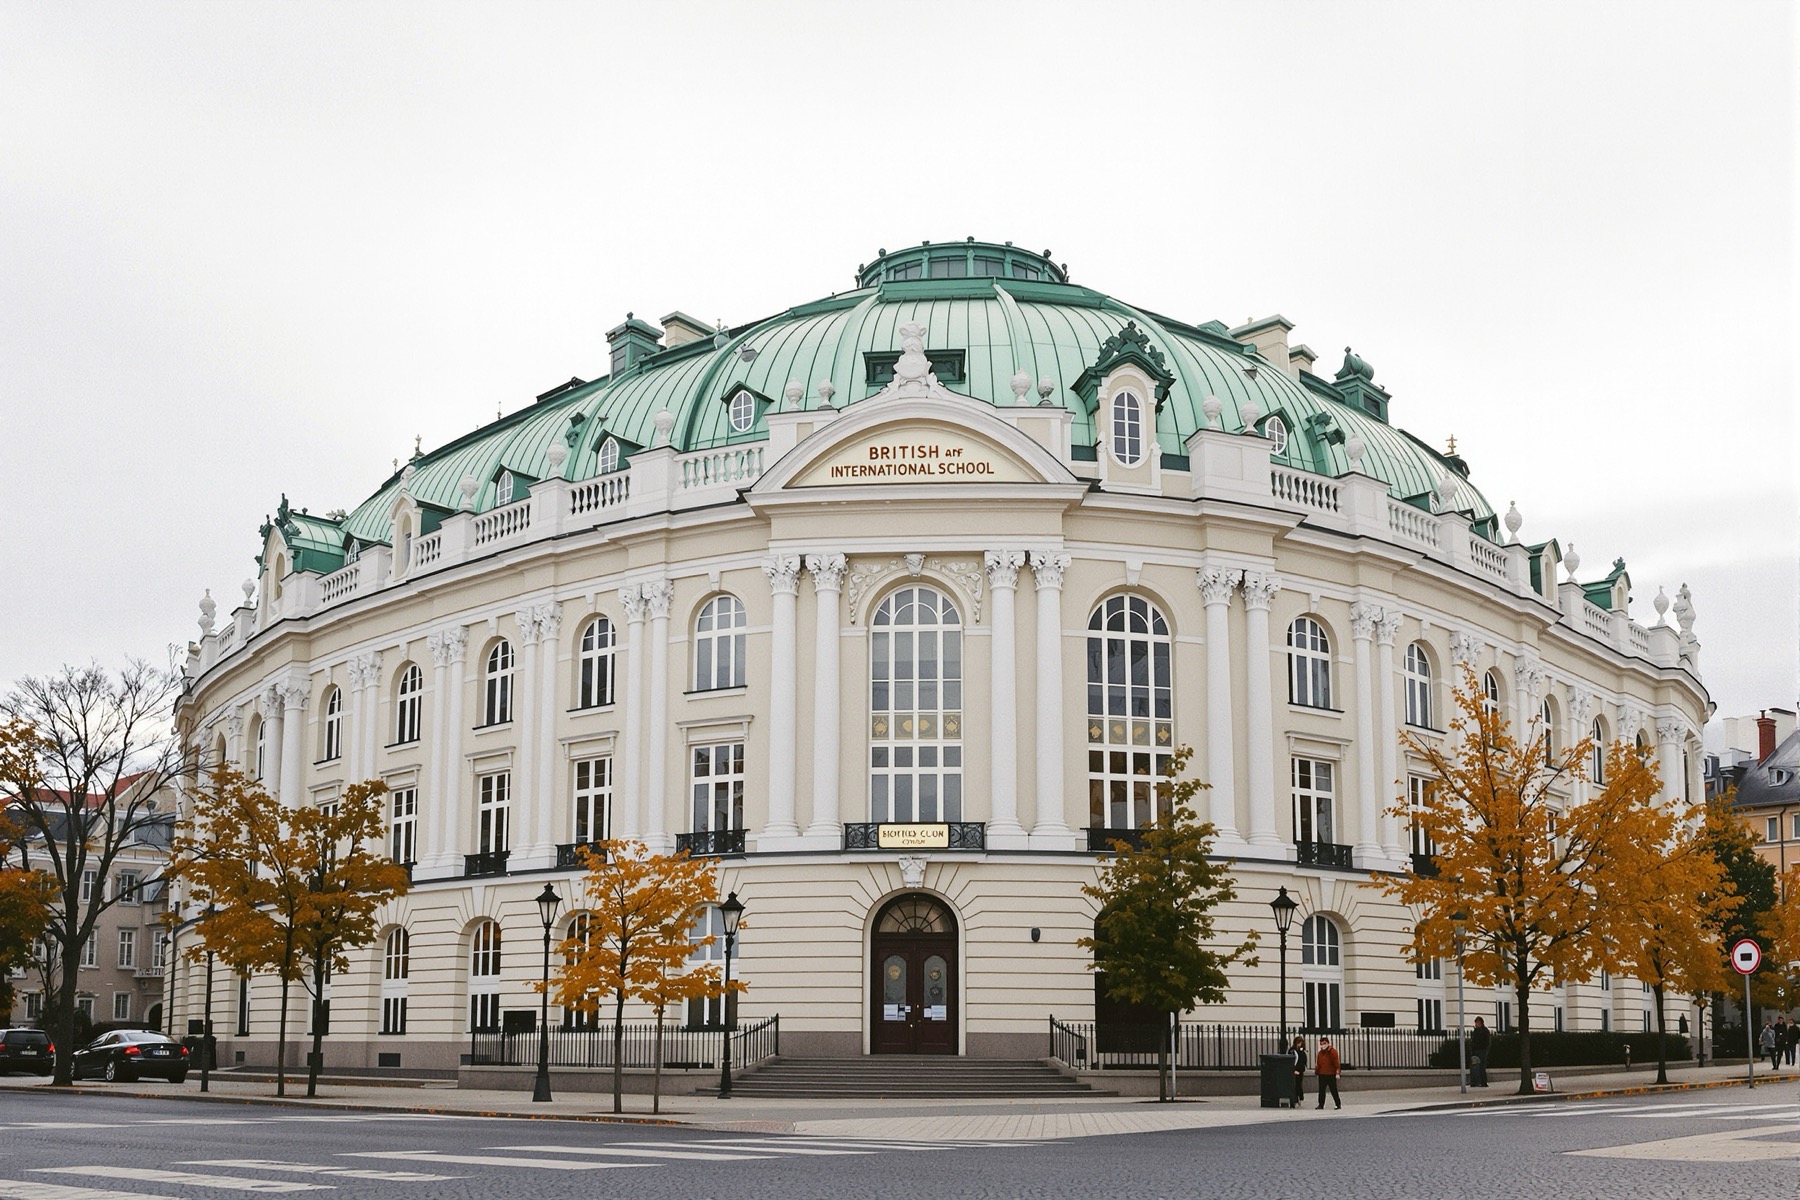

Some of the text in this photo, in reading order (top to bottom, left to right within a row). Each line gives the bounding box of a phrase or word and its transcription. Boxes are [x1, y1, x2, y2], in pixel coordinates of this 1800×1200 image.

[869, 445, 939, 460] BRITISH
[831, 462, 994, 478] INTERNATIONAL SCHOOL
